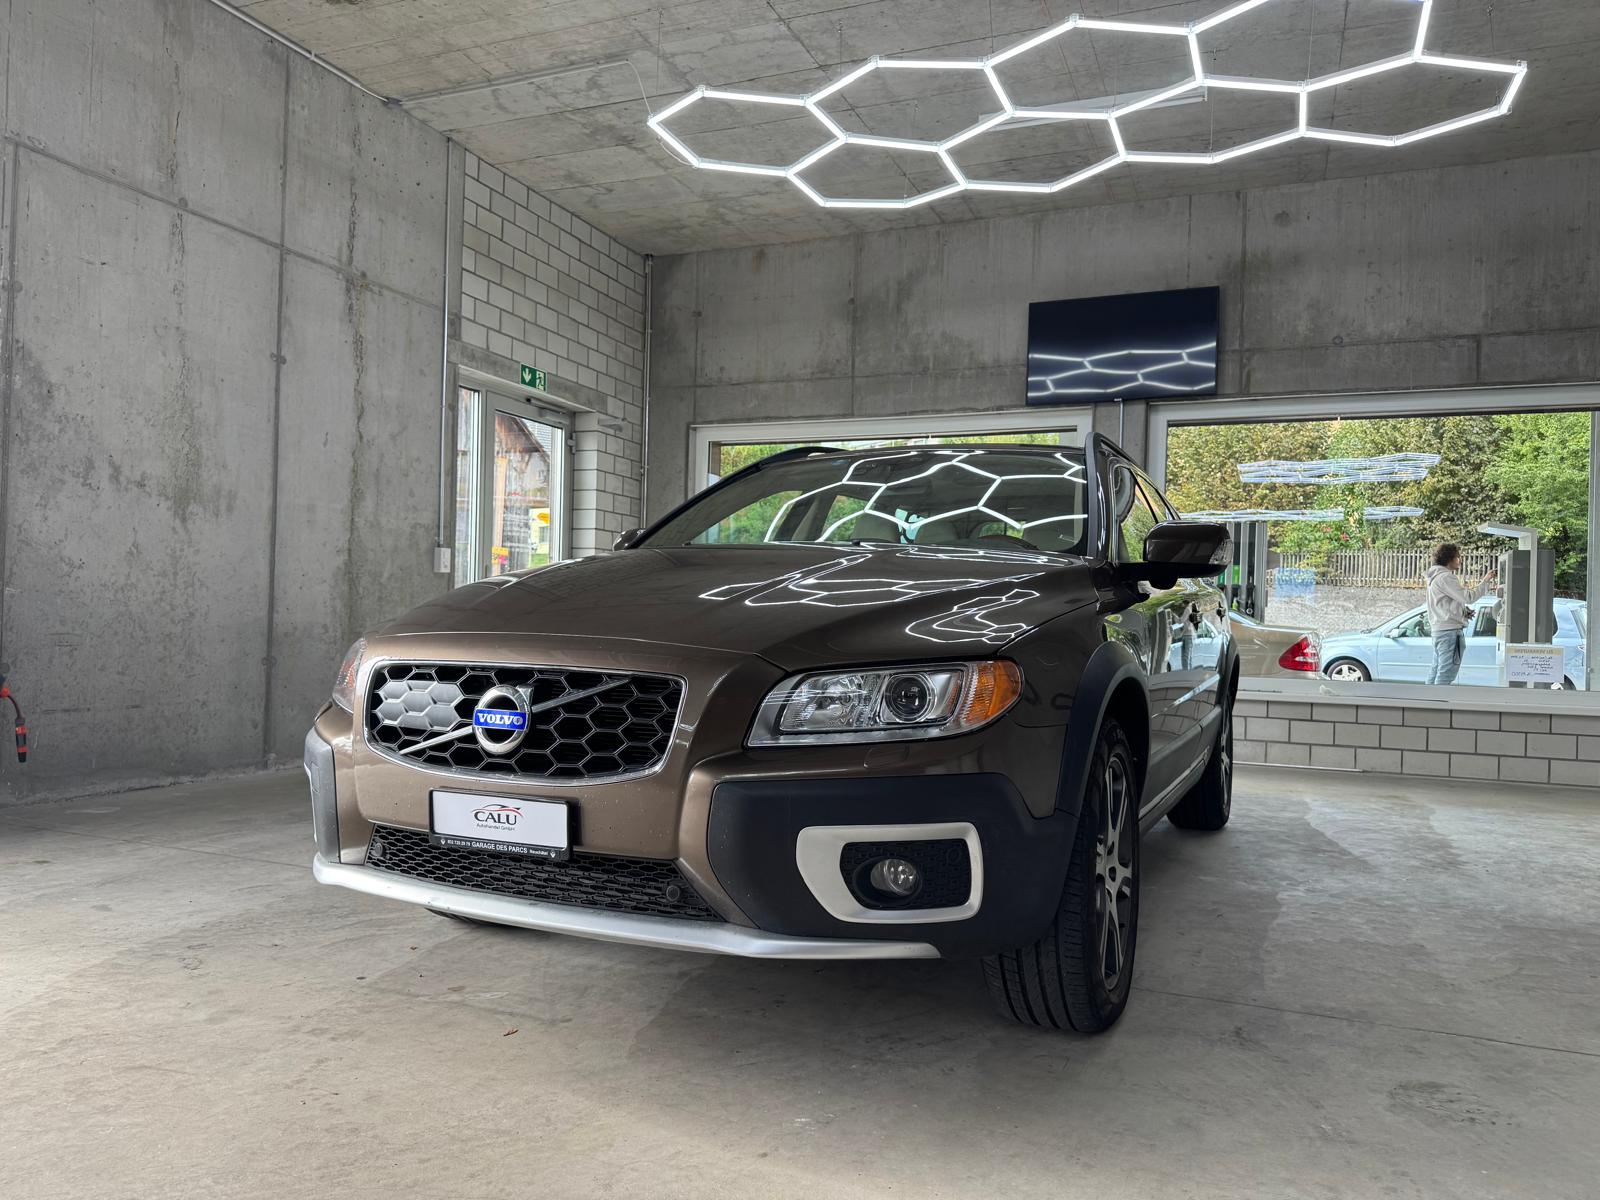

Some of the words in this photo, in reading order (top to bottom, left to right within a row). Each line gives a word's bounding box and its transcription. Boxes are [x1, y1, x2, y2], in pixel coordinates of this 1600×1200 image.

[477, 713, 523, 725] VOLVO
[474, 811, 517, 825] CALU
[471, 841, 495, 849] GARAGE
[508, 845, 528, 853] PARCS
